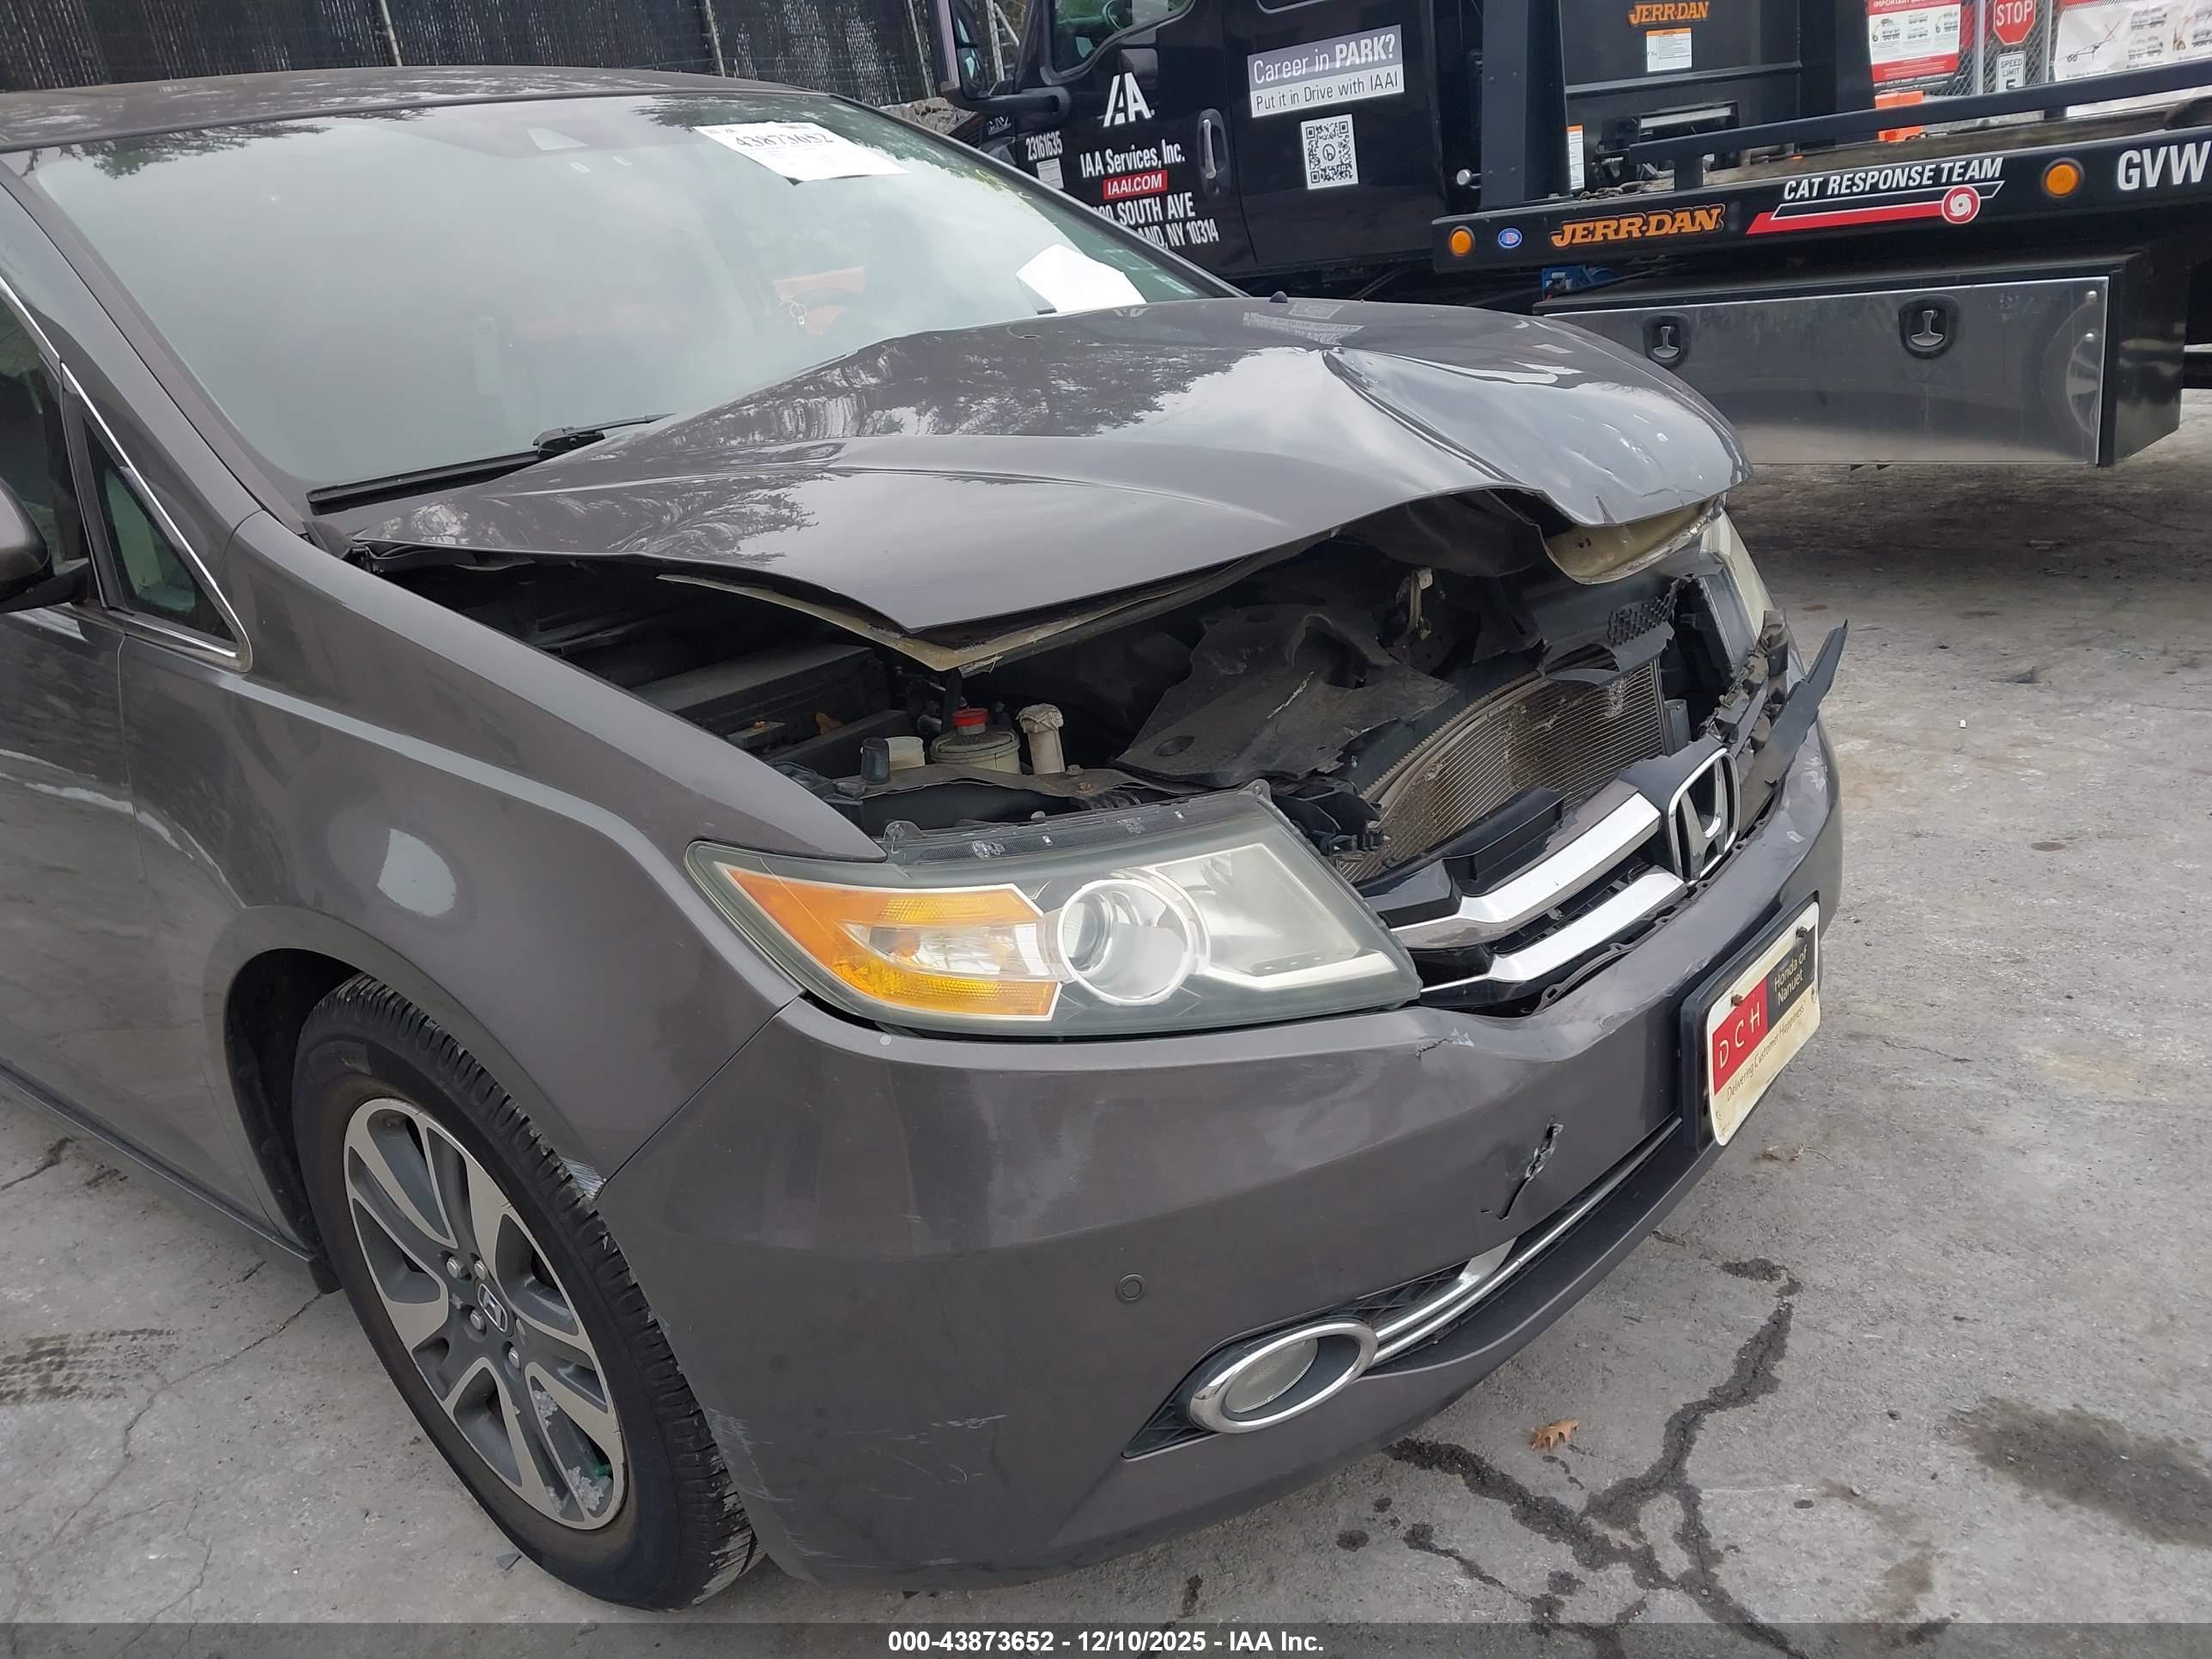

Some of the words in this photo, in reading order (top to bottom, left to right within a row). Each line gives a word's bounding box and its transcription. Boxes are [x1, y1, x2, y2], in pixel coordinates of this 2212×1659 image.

[1996, 0, 2033, 27] STOP
[1254, 57, 1309, 83] Career
[1315, 48, 1329, 72] in
[1335, 33, 1395, 69] PARK?
[2001, 58, 2022, 68] SPEED
[2002, 68, 2021, 77] LIMIT
[1256, 94, 1275, 111] Put
[1279, 91, 1287, 108] it
[1290, 89, 1299, 104] in
[1304, 84, 1334, 102] Drive
[1338, 78, 1365, 96] with
[1370, 70, 1399, 91] IAAI
[1025, 130, 1063, 161] 23161635
[1079, 150, 1105, 179] IAA
[1105, 143, 1162, 174] Services,
[1161, 138, 1186, 165] Inc.
[1108, 173, 1162, 196] IAAI.COM
[1784, 177, 1823, 200] CAT
[1826, 164, 1936, 196] RESPONSE
[1940, 156, 2004, 184] TEAM
[2118, 140, 2212, 191] GVW
[1117, 197, 1164, 226] SOUTH
[1167, 191, 1195, 220] AVE
[1165, 222, 1186, 247] NY
[1186, 218, 1219, 245] 10314
[1774, 957, 1798, 992] Honda
[1798, 945, 1808, 965] of
[1778, 968, 1803, 1007] Nanuet
[1727, 1064, 1753, 1102] Delivering
[1754, 1033, 1779, 1068] Customer
